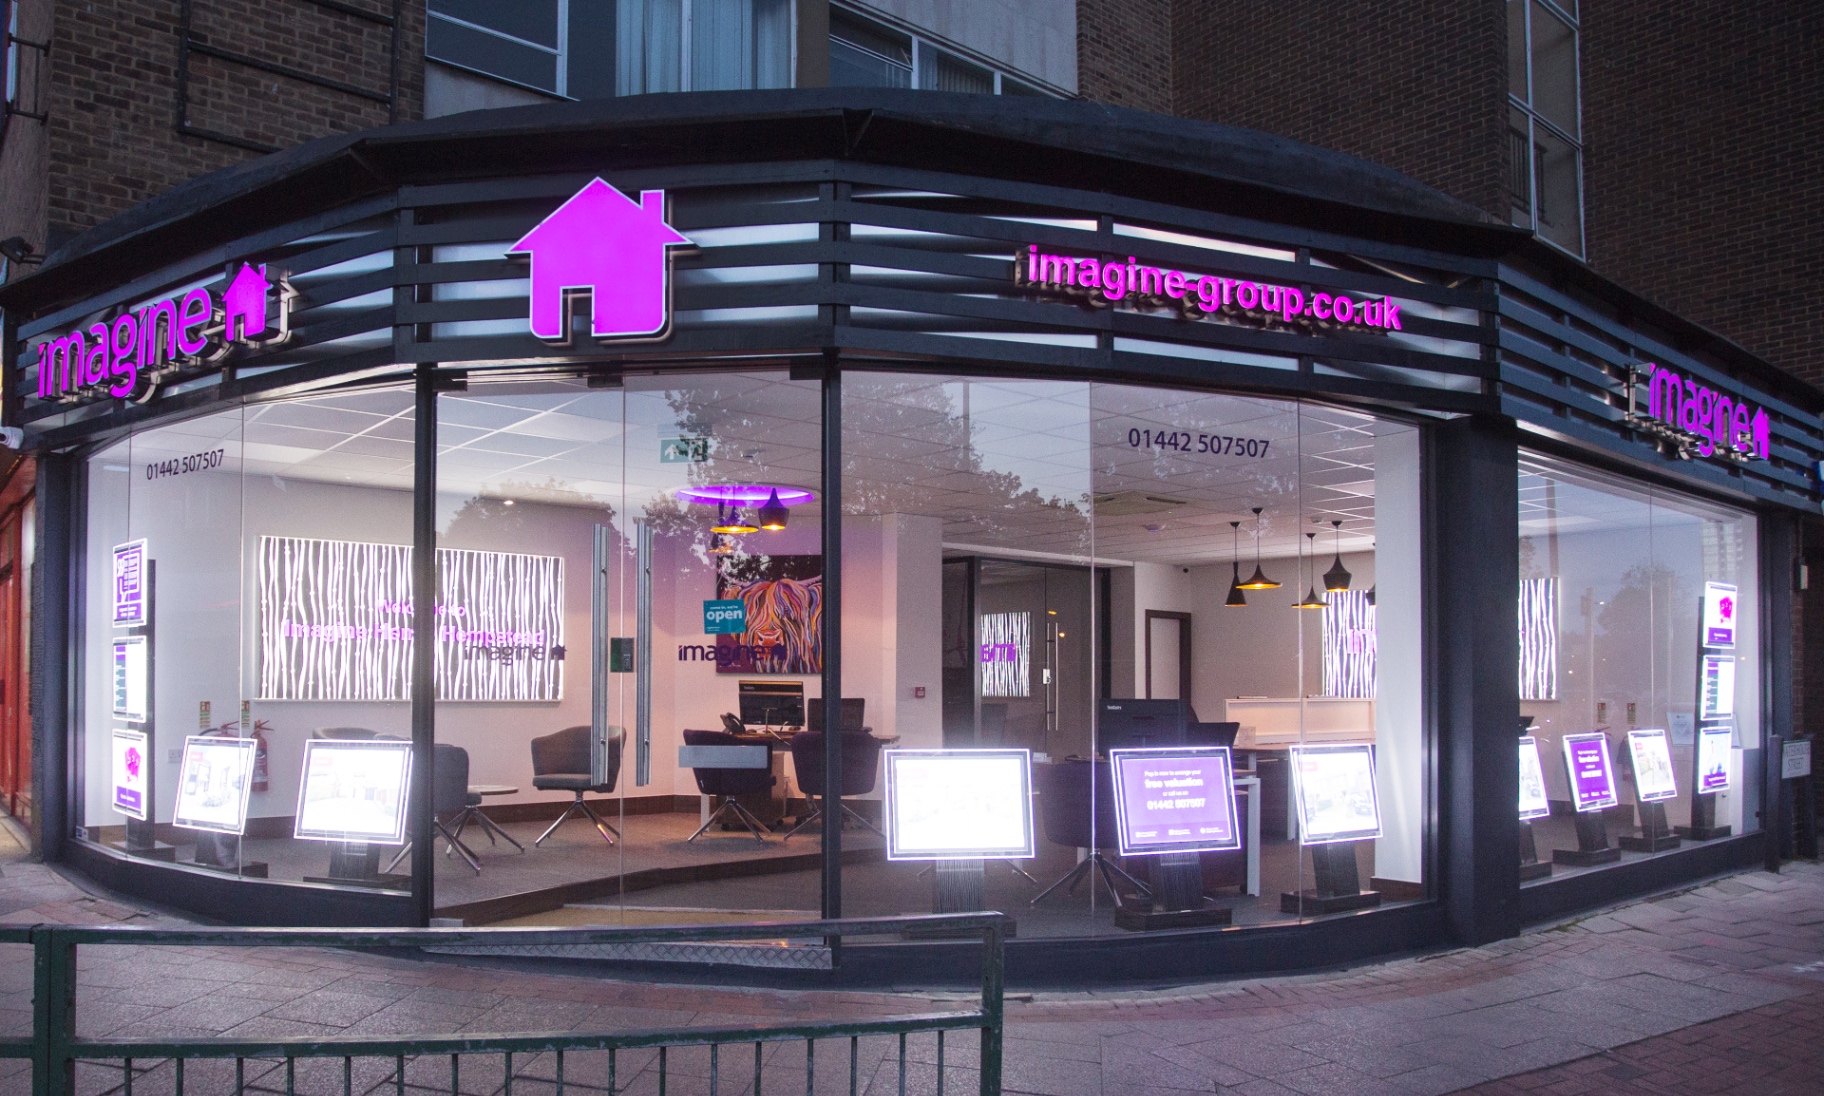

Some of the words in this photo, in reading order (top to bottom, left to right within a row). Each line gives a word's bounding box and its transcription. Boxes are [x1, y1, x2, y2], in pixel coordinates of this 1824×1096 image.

[1028, 244, 1402, 330] imagine-group.co.uk
[38, 287, 212, 398] imagine
[1648, 363, 1750, 457] imagine
[1128, 428, 1192, 452] 01442
[1197, 434, 1270, 458] 507507
[146, 458, 179, 480] 01442
[182, 448, 224, 474] 507507
[283, 619, 367, 642] Imagine
[706, 609, 743, 623] open
[464, 645, 545, 666] imagine
[678, 644, 766, 667] imagine
